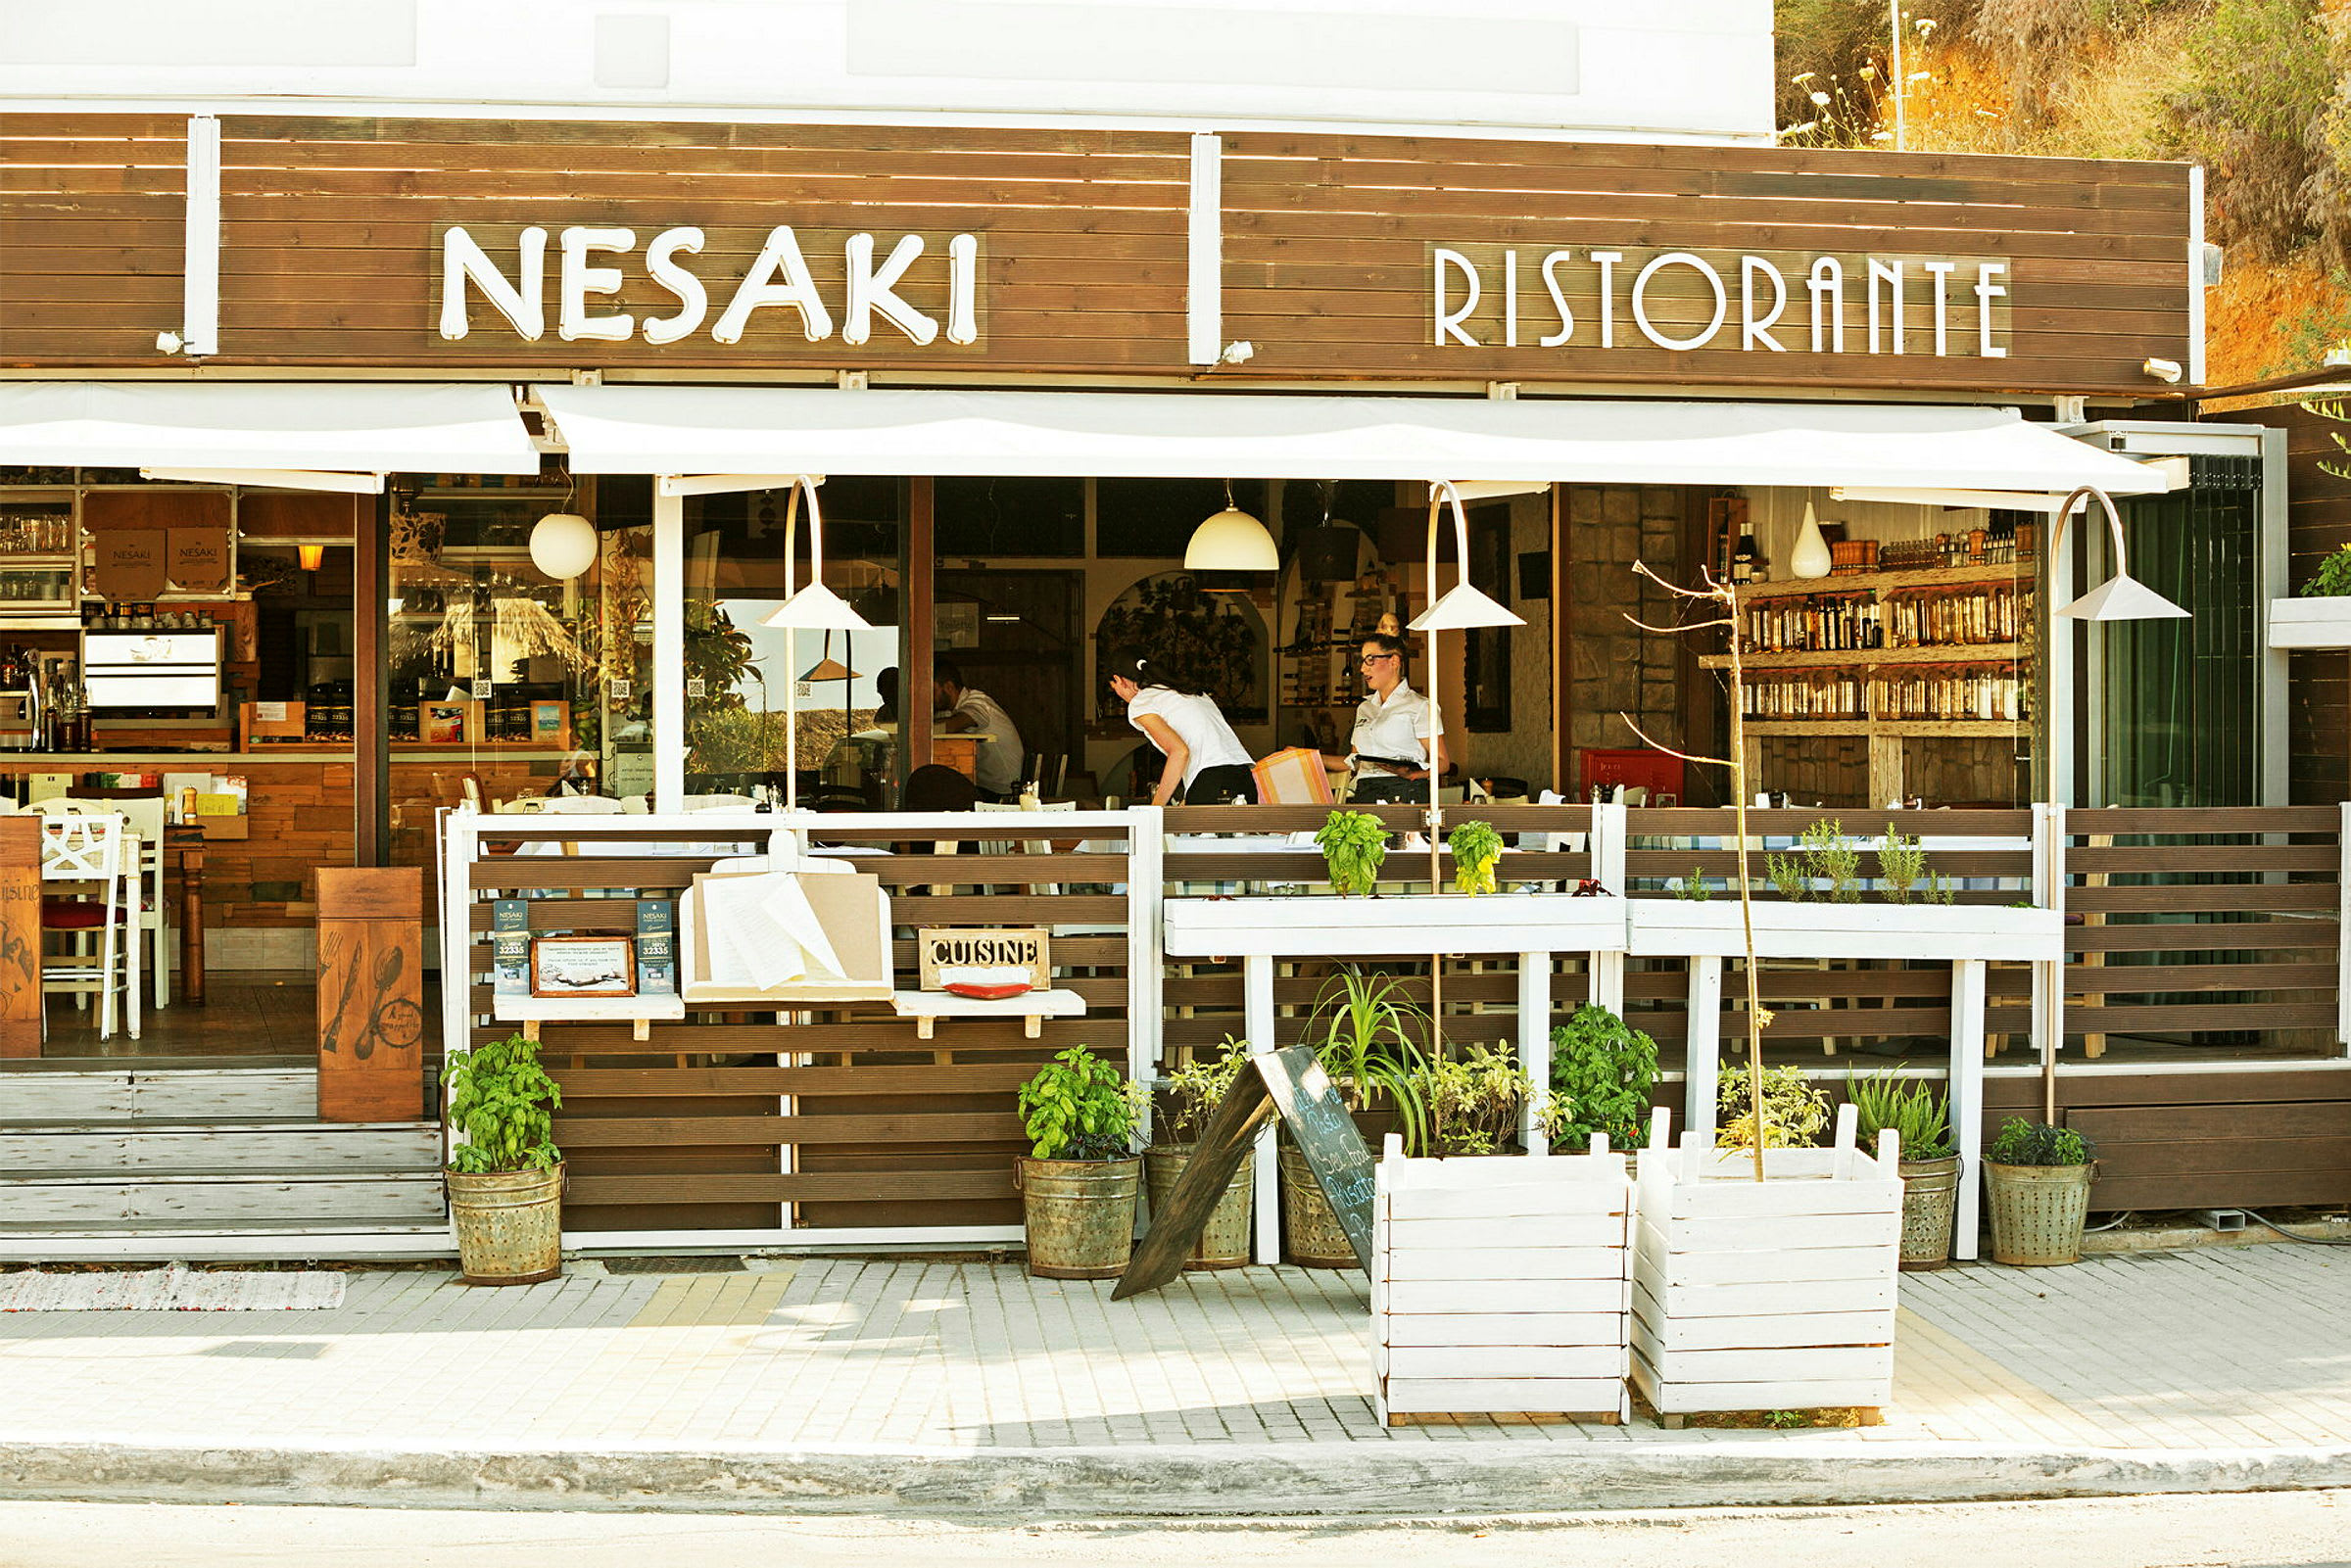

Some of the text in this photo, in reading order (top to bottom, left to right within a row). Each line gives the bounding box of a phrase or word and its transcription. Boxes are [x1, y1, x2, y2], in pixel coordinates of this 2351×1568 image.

[440, 224, 978, 346] NESAKI
[1434, 248, 2007, 358] RISTORANTE
[113, 550, 150, 559] NESAKI
[179, 548, 217, 557] NESAKI
[499, 946, 525, 955] 32335
[932, 939, 1038, 965] CUISINE
